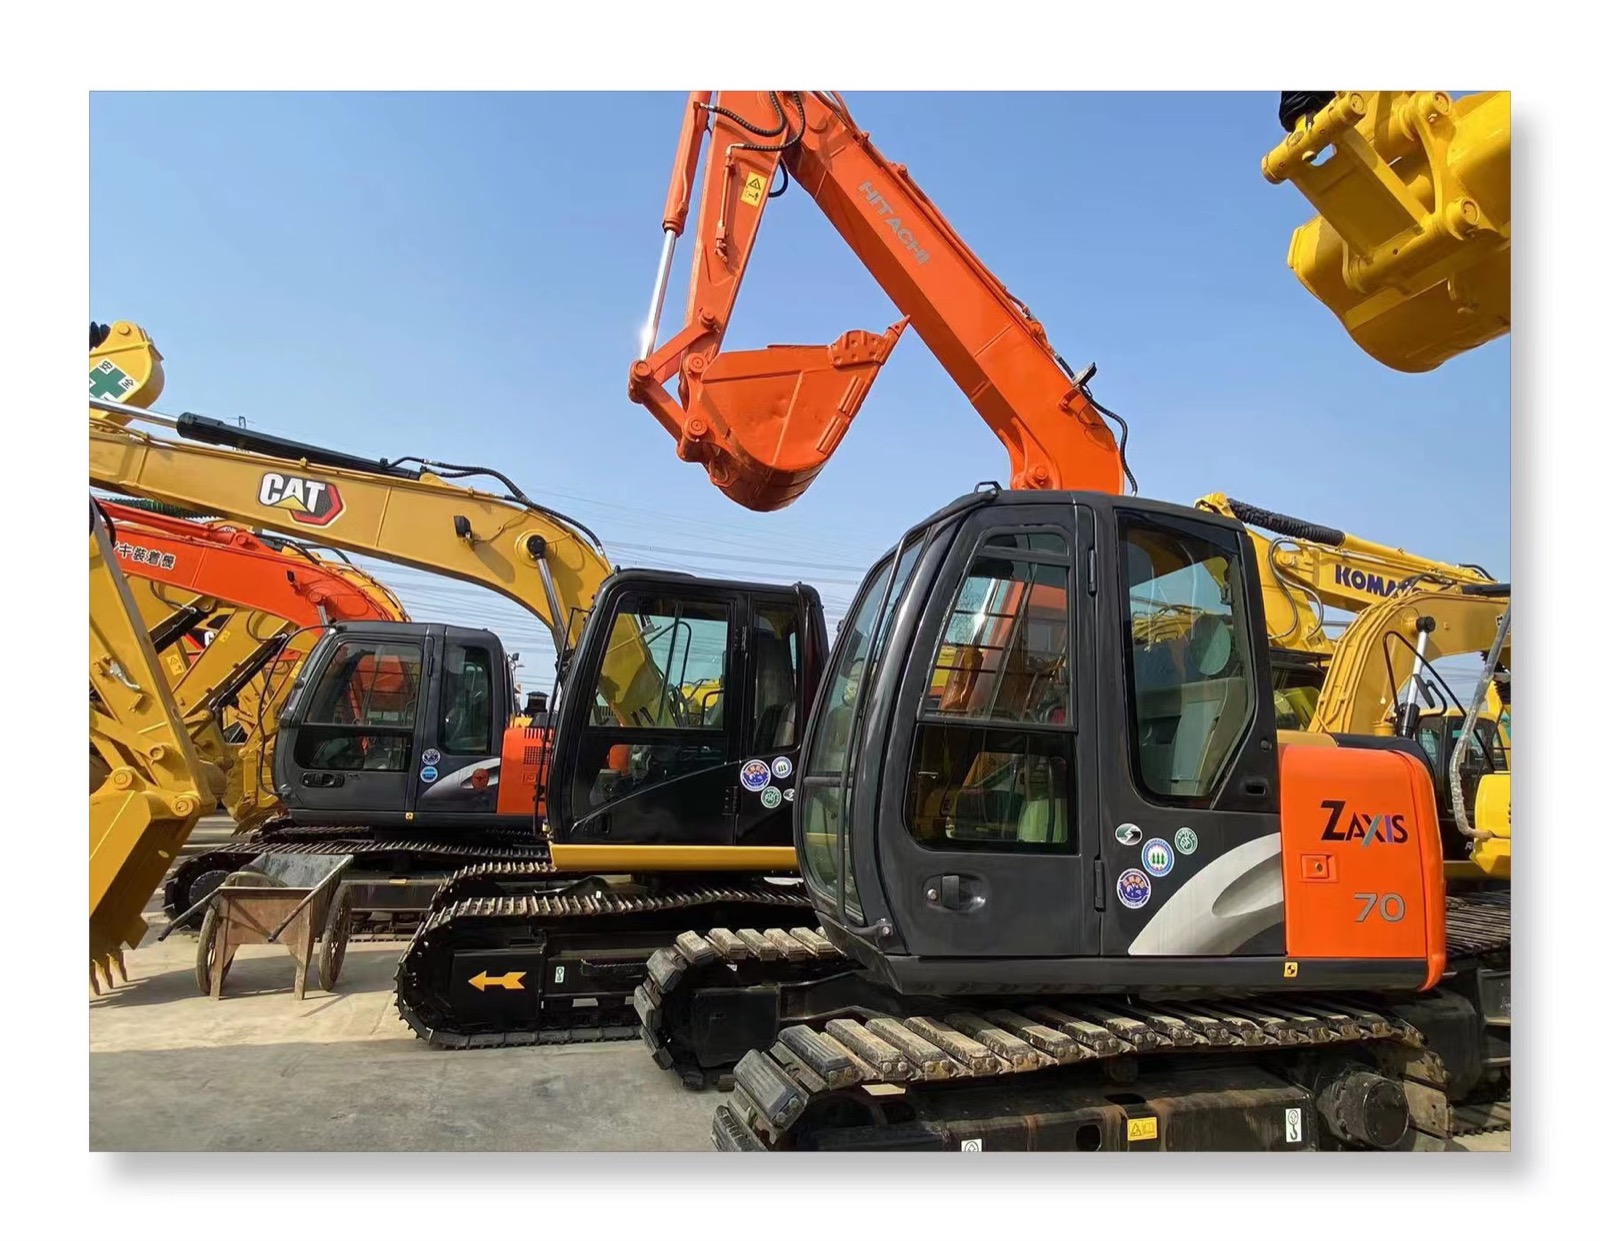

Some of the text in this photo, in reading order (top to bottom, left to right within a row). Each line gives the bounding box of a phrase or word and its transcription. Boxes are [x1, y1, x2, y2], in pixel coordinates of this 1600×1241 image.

[857, 180, 930, 266] HITACHI
[259, 473, 326, 513] CAT
[1320, 800, 1408, 846] ZAXIS
[1354, 892, 1406, 923] 70
